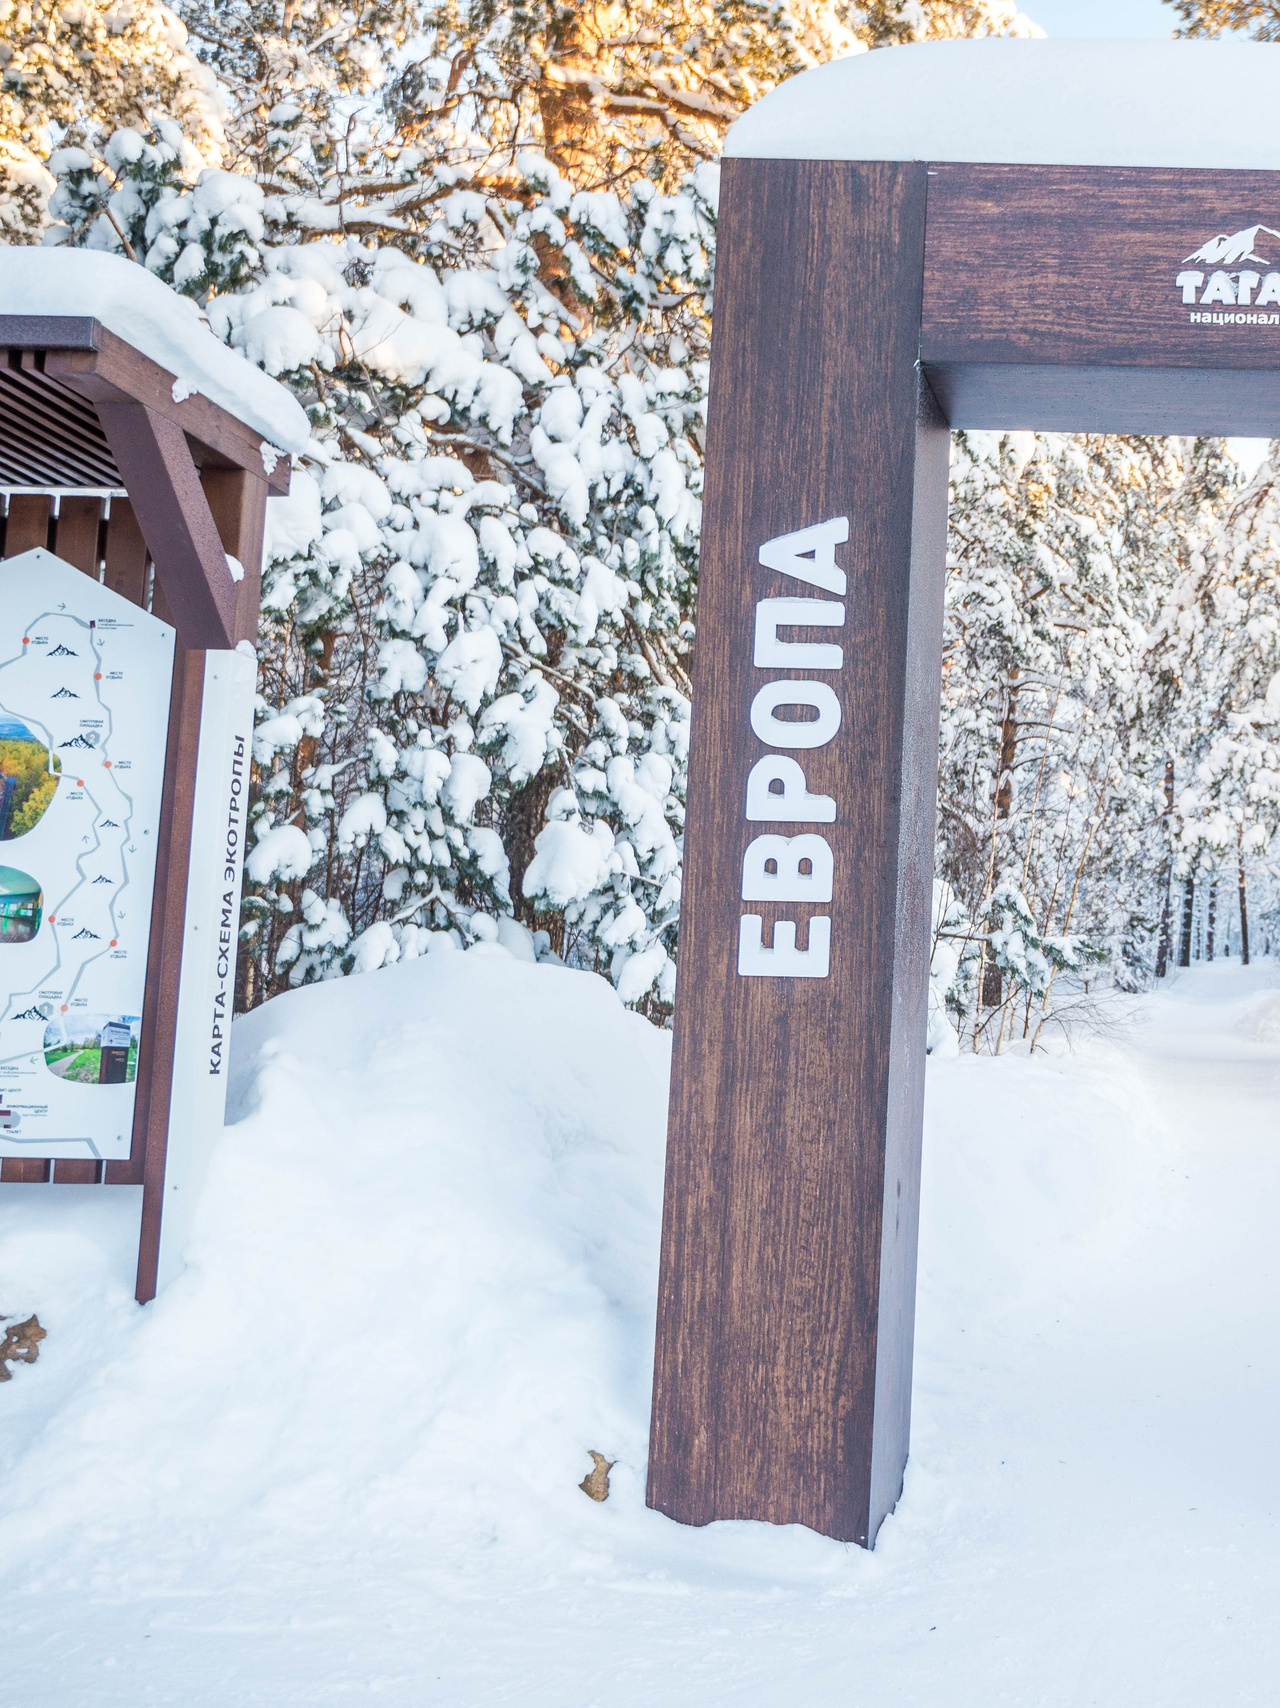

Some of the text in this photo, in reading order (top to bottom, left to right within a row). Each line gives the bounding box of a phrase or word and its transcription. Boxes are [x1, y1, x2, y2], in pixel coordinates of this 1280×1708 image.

[209, 735, 245, 1075] КАРТА-СХЕМА ЭКОТРОПЫ
[738, 516, 849, 978] ЕВРОПА
